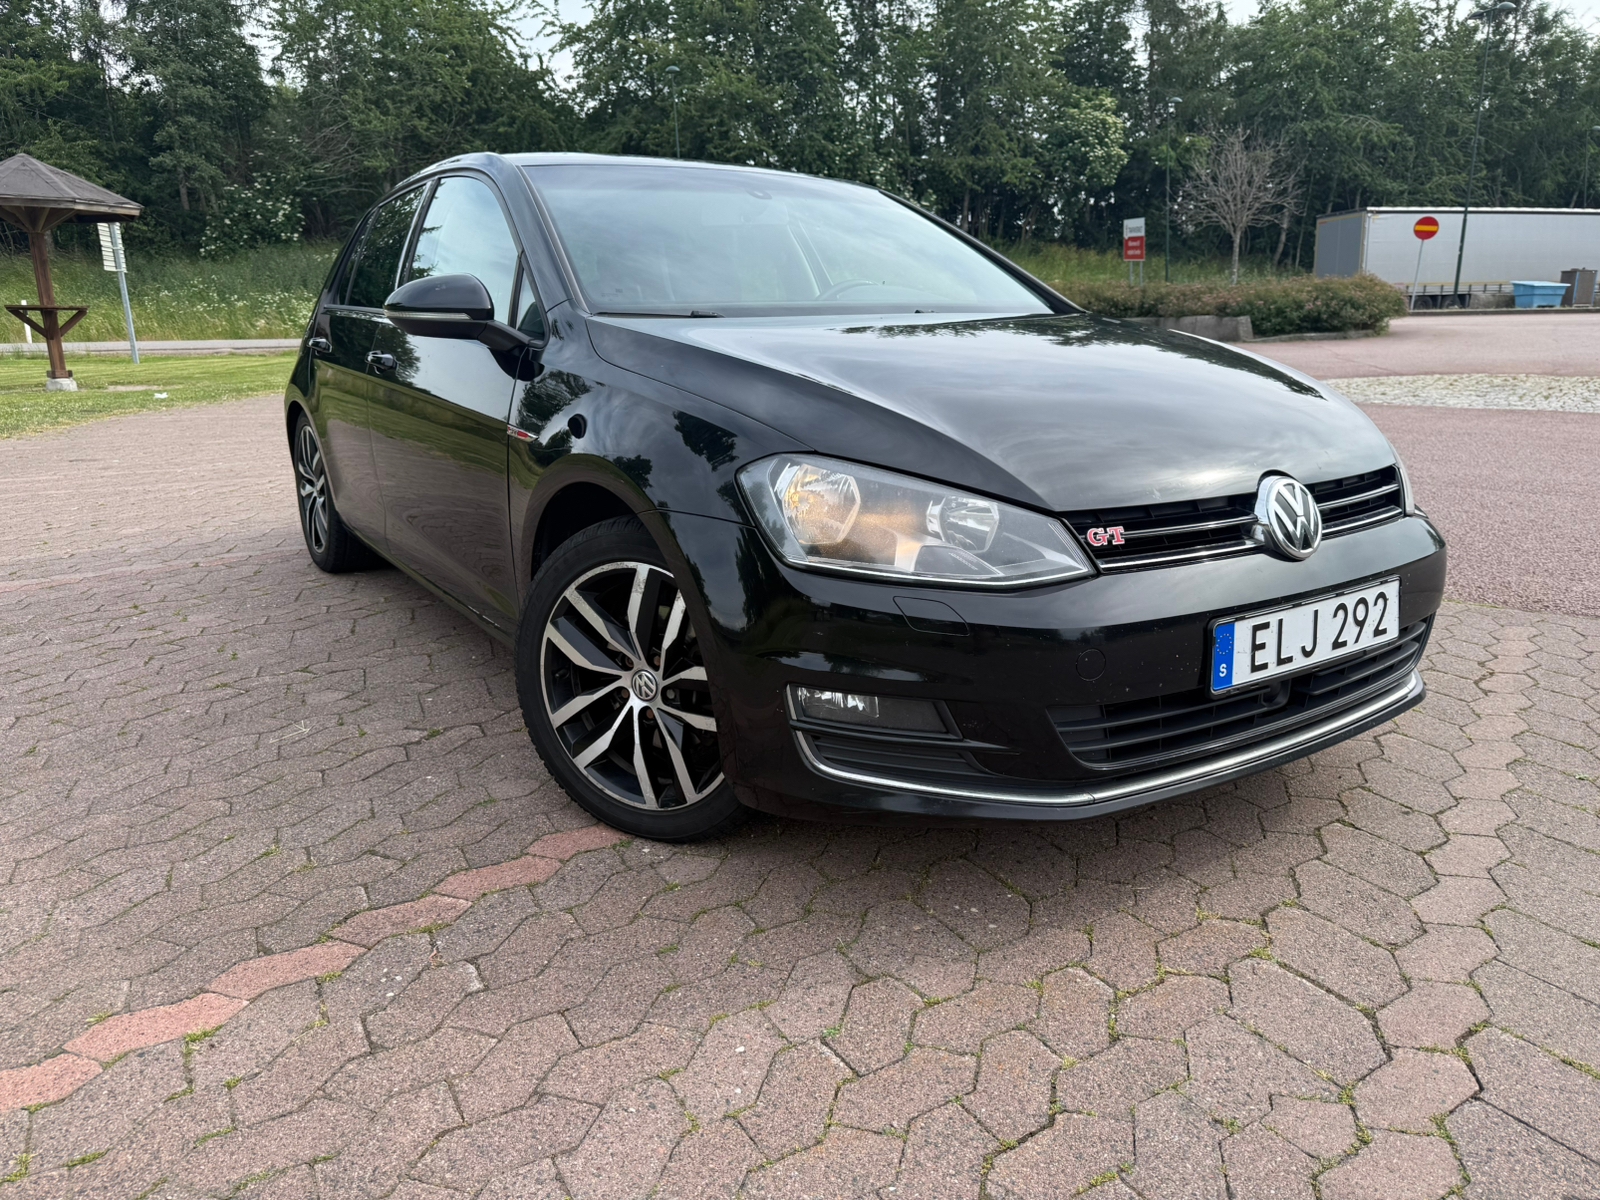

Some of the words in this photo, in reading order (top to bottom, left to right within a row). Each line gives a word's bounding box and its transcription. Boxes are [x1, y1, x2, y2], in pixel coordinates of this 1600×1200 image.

[1087, 526, 1125, 546] GT
[1250, 608, 1319, 674] ELJ
[1332, 591, 1389, 651] 292
[1219, 663, 1227, 678] S
